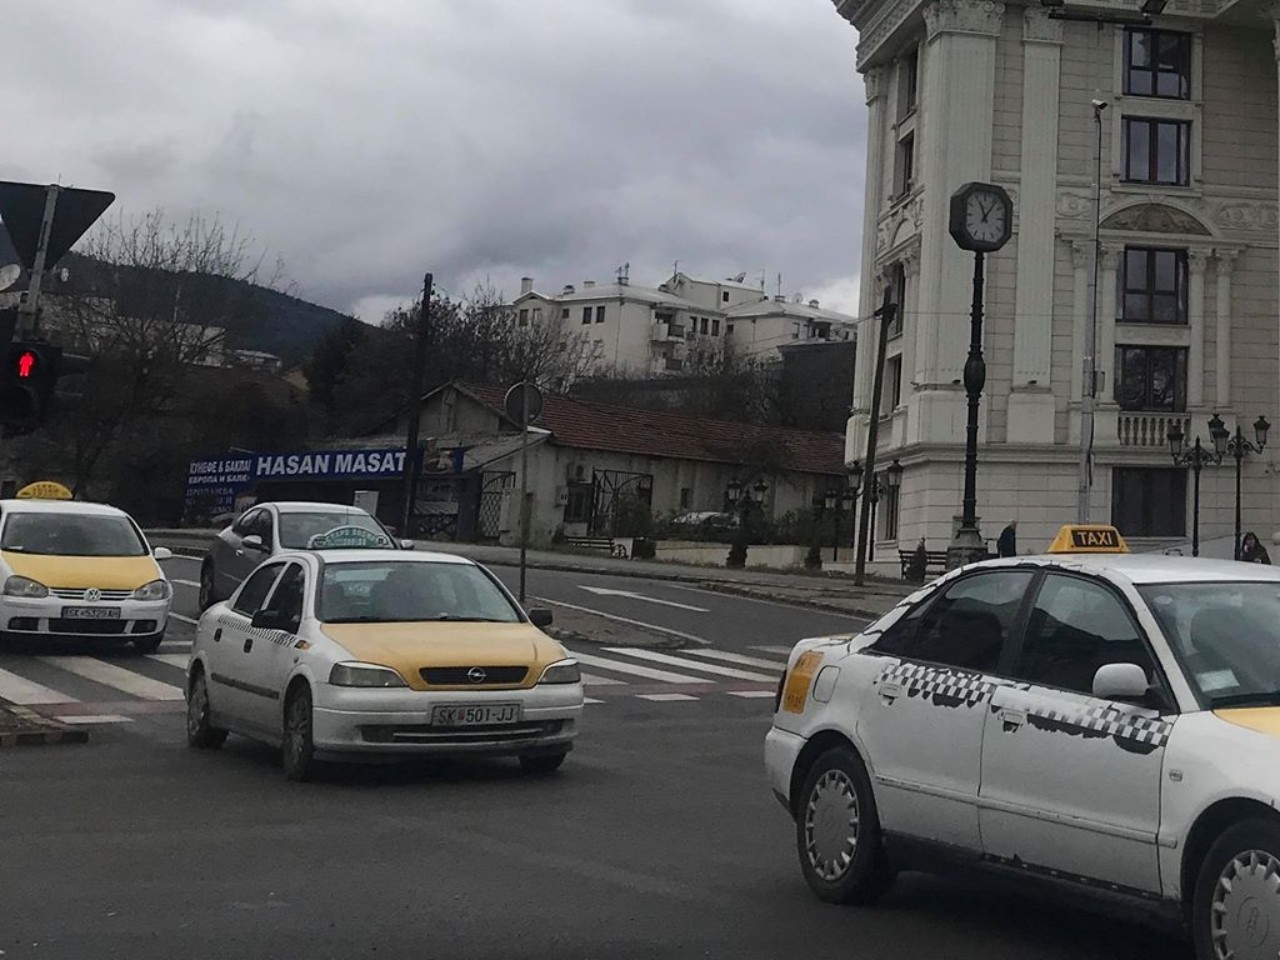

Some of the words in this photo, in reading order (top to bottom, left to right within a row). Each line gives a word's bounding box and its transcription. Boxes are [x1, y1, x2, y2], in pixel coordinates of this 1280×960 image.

[256, 453, 330, 476] HASAN
[335, 452, 406, 473] MASAT
[1077, 532, 1113, 545] TAXI
[439, 708, 457, 723] SK
[465, 707, 514, 723] 501-JJ
